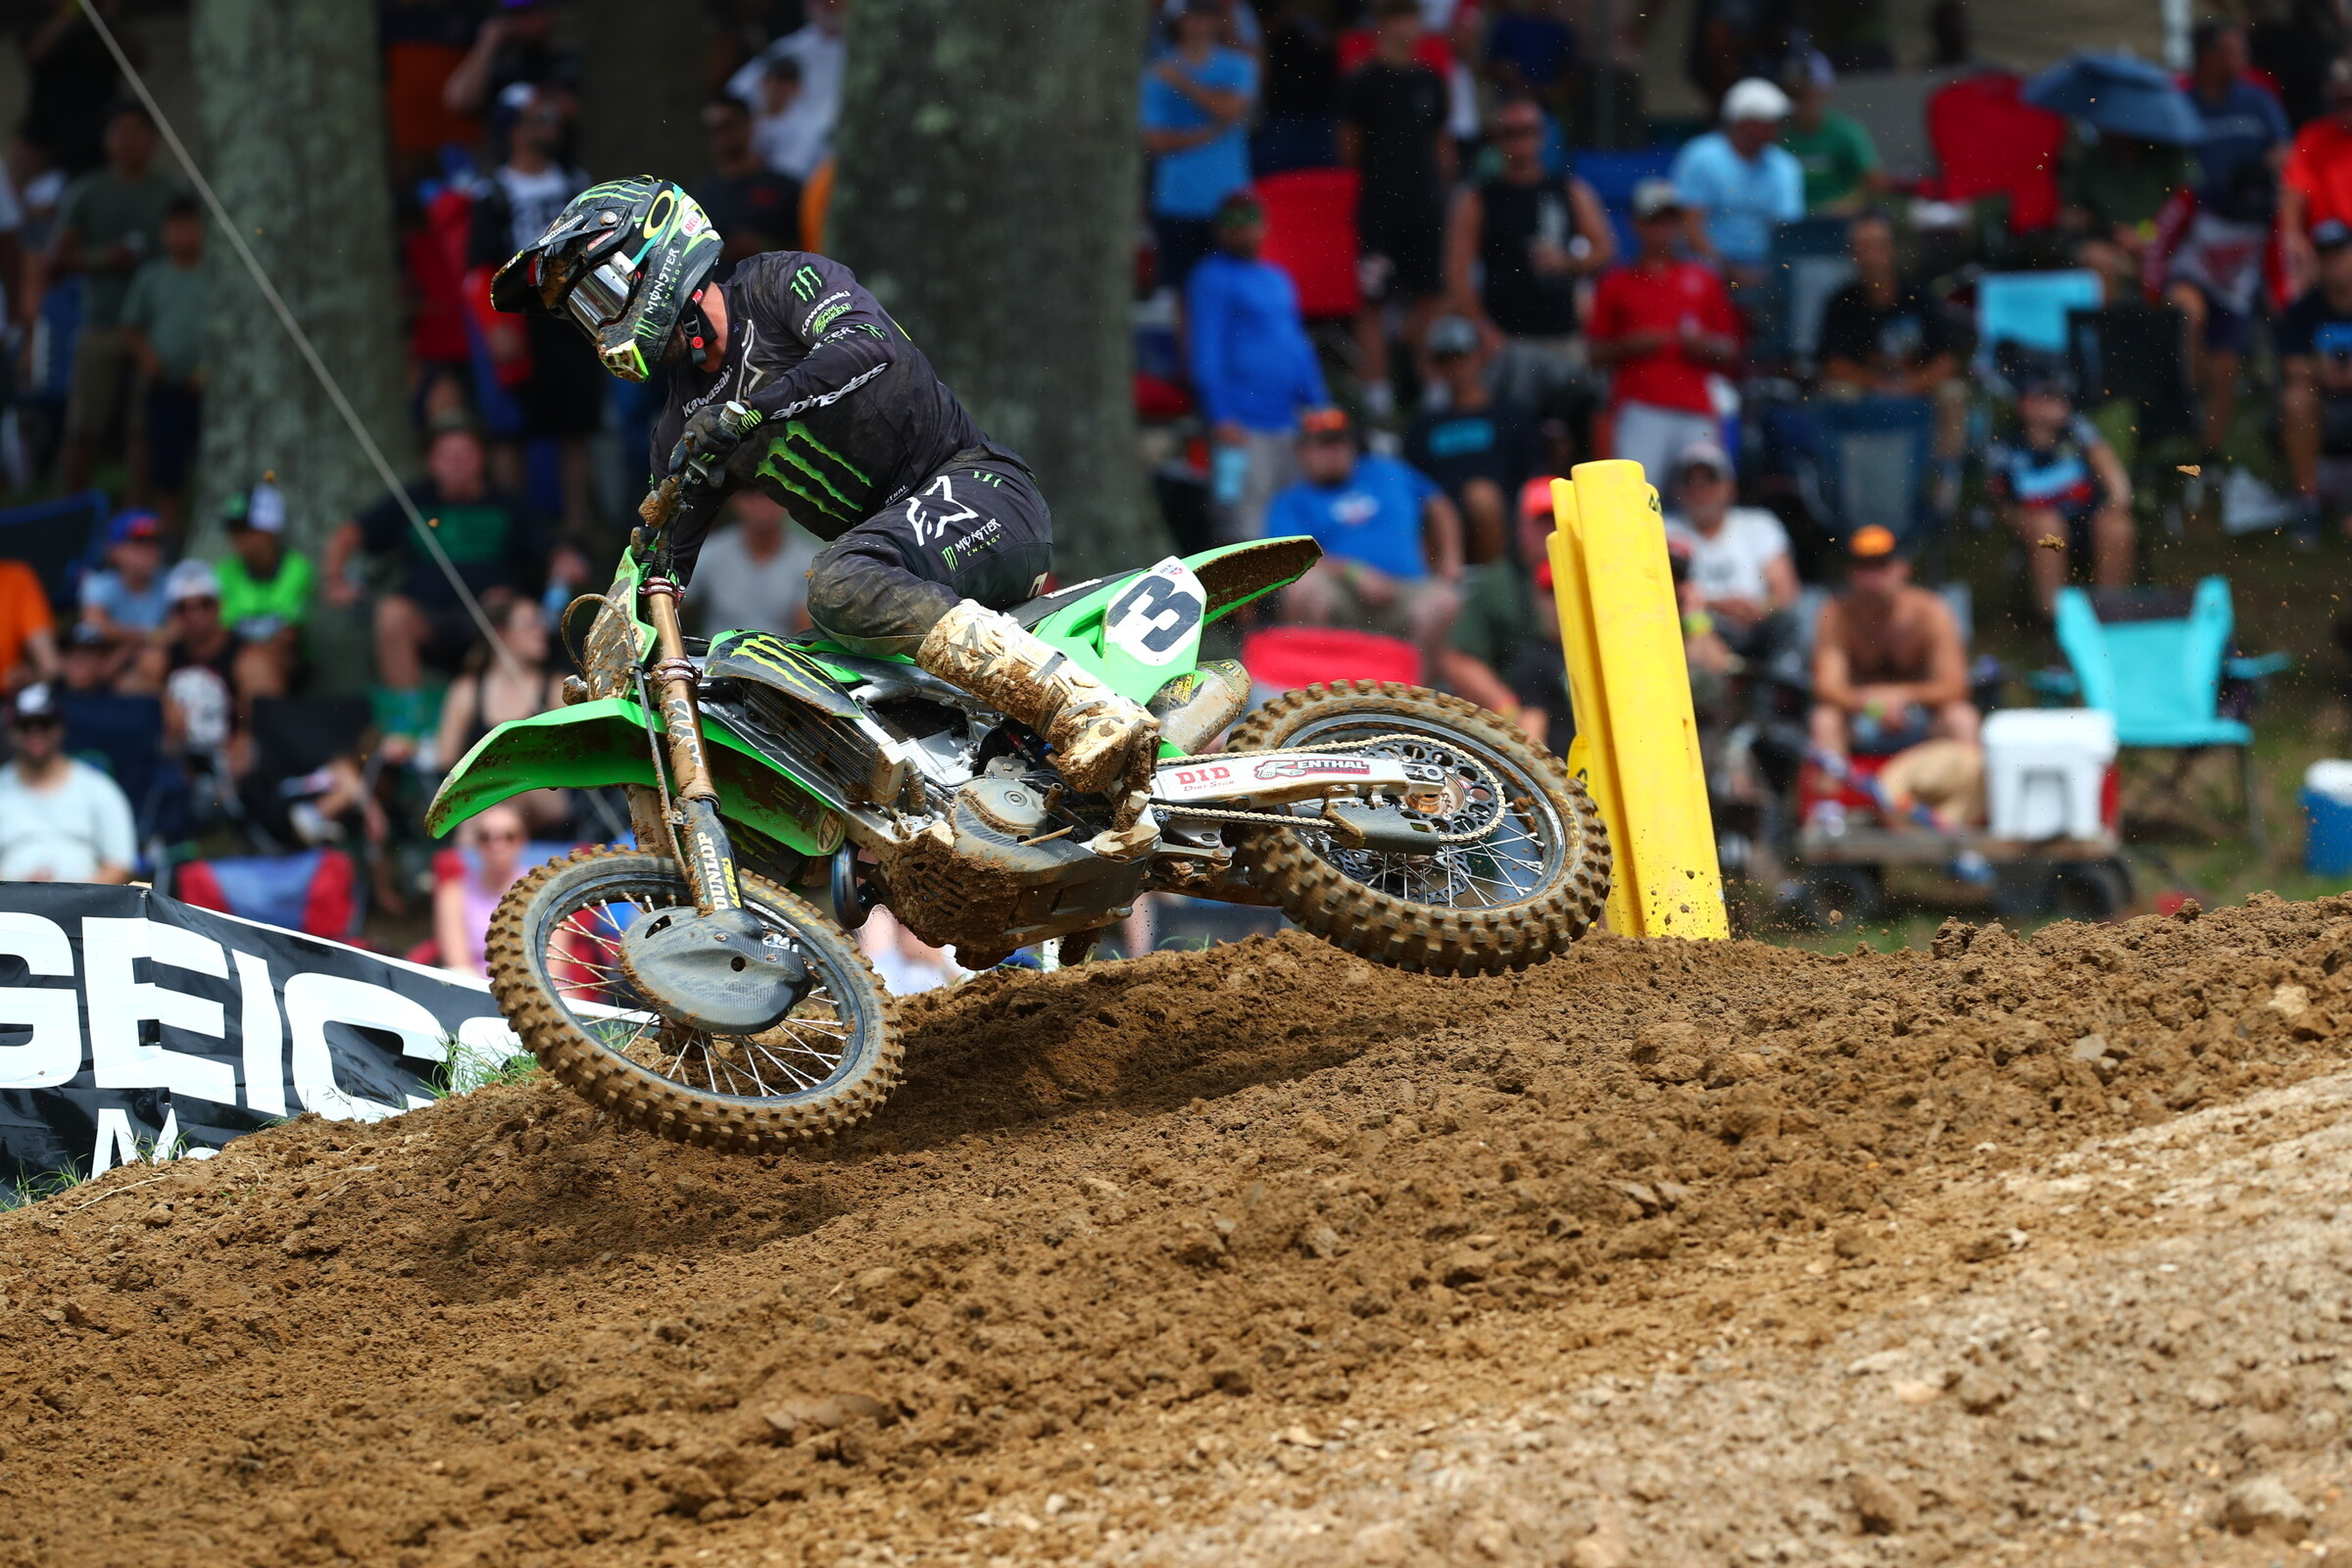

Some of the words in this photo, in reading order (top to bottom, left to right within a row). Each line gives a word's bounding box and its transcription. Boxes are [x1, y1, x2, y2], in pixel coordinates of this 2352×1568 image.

[685, 214, 700, 232] BELL
[645, 247, 680, 315] MONSTER
[661, 261, 683, 309] ENERGY
[801, 290, 852, 337] Kawasaki
[682, 365, 733, 418] Kawasaki
[955, 517, 1002, 553] MONSTER
[1107, 575, 1202, 653] 3
[697, 831, 729, 911] DUNLOP
[740, 878, 818, 927] UNLOP
